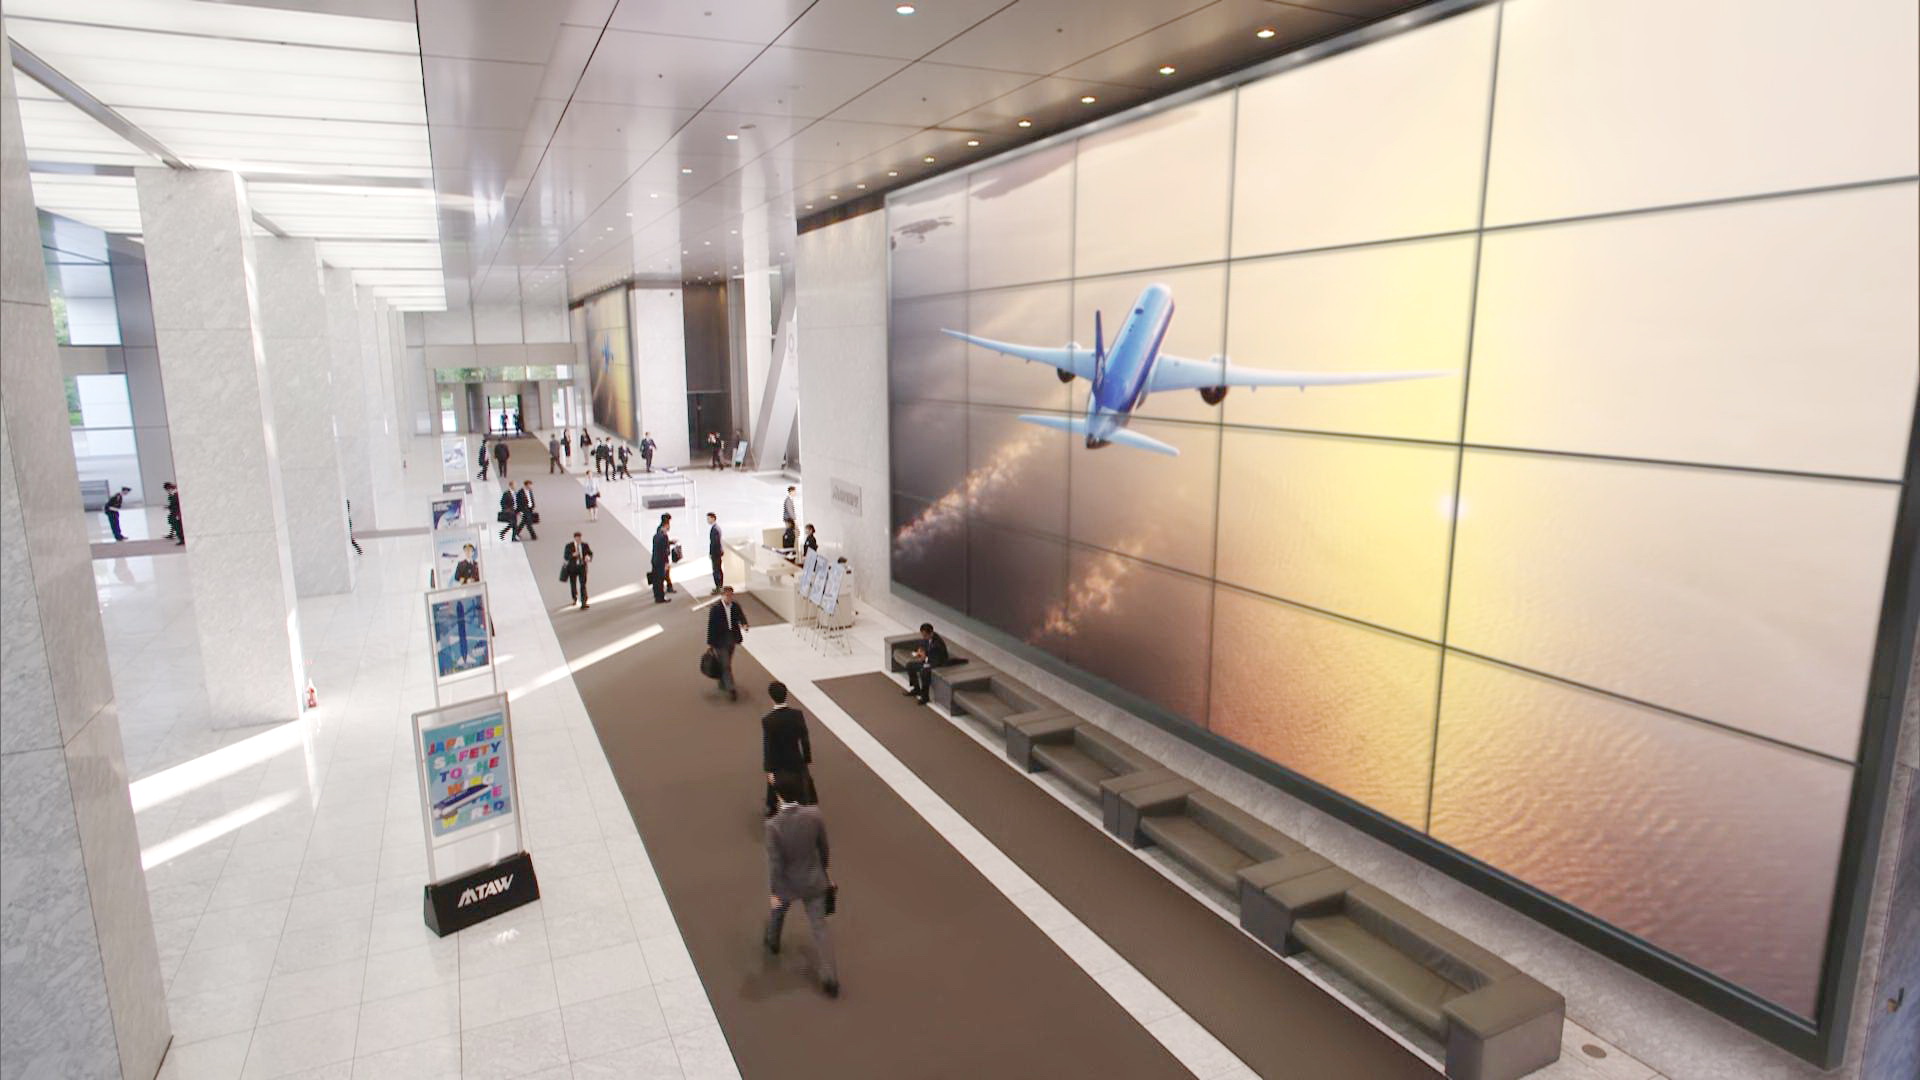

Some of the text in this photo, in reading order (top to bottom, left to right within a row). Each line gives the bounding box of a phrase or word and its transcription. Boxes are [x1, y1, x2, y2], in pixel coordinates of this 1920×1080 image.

[428, 725, 504, 756] JAPANESE
[434, 740, 501, 770] SAFETY
[440, 756, 500, 783] TO THE
